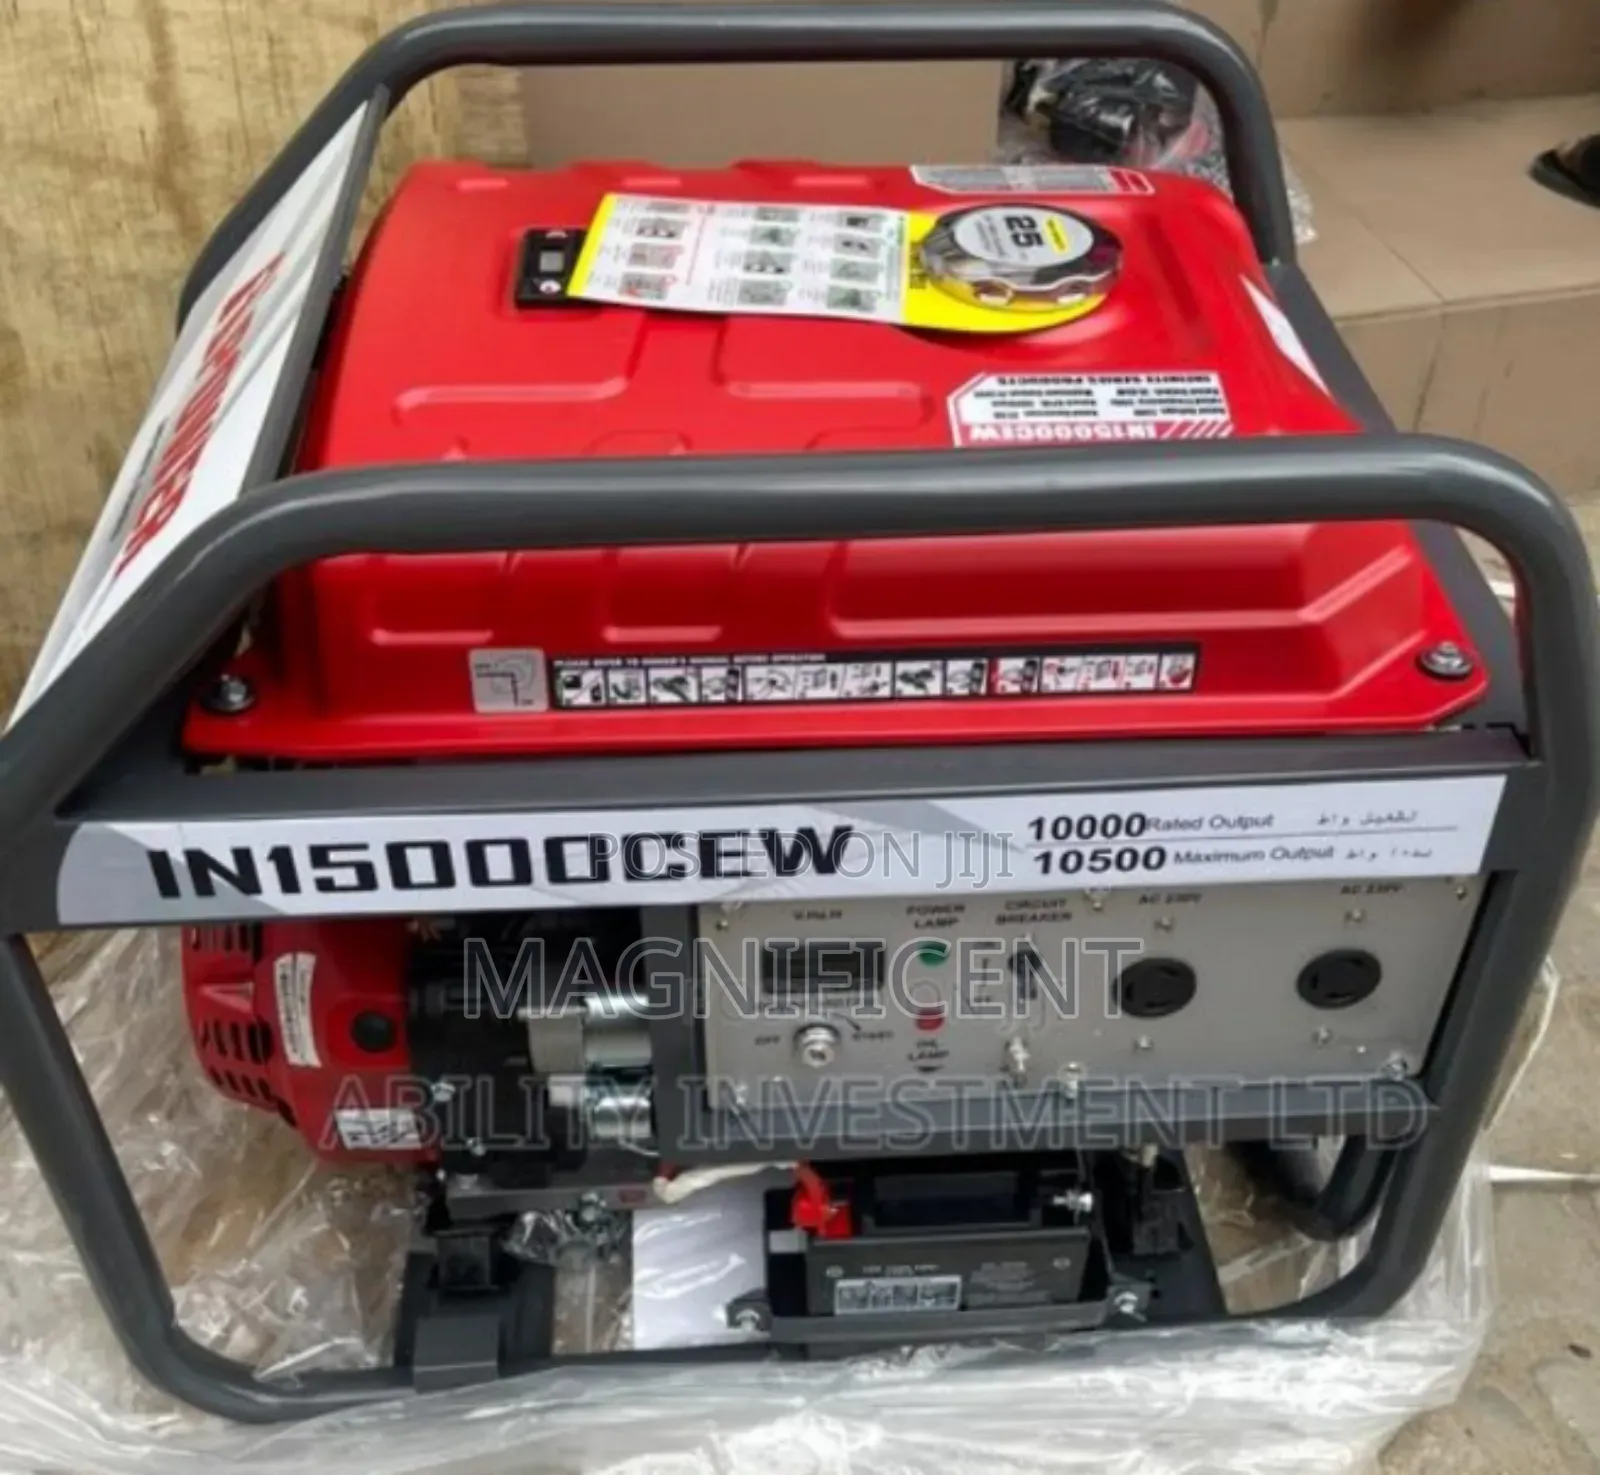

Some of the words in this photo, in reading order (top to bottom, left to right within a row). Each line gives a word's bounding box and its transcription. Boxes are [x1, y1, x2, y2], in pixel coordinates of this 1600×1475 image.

[1004, 214, 1044, 248] 25
[1028, 812, 1147, 842] 10000
[1147, 815, 1203, 831] Rated
[1209, 813, 1274, 830] Output
[146, 826, 853, 898] IN15000CEW
[1034, 845, 1168, 875] 10500
[1174, 849, 1266, 866] Maximum
[1269, 845, 1335, 862] Output
[906, 903, 966, 916] POWER
[914, 916, 960, 930] LAMP
[994, 911, 1073, 926] BREAKER
